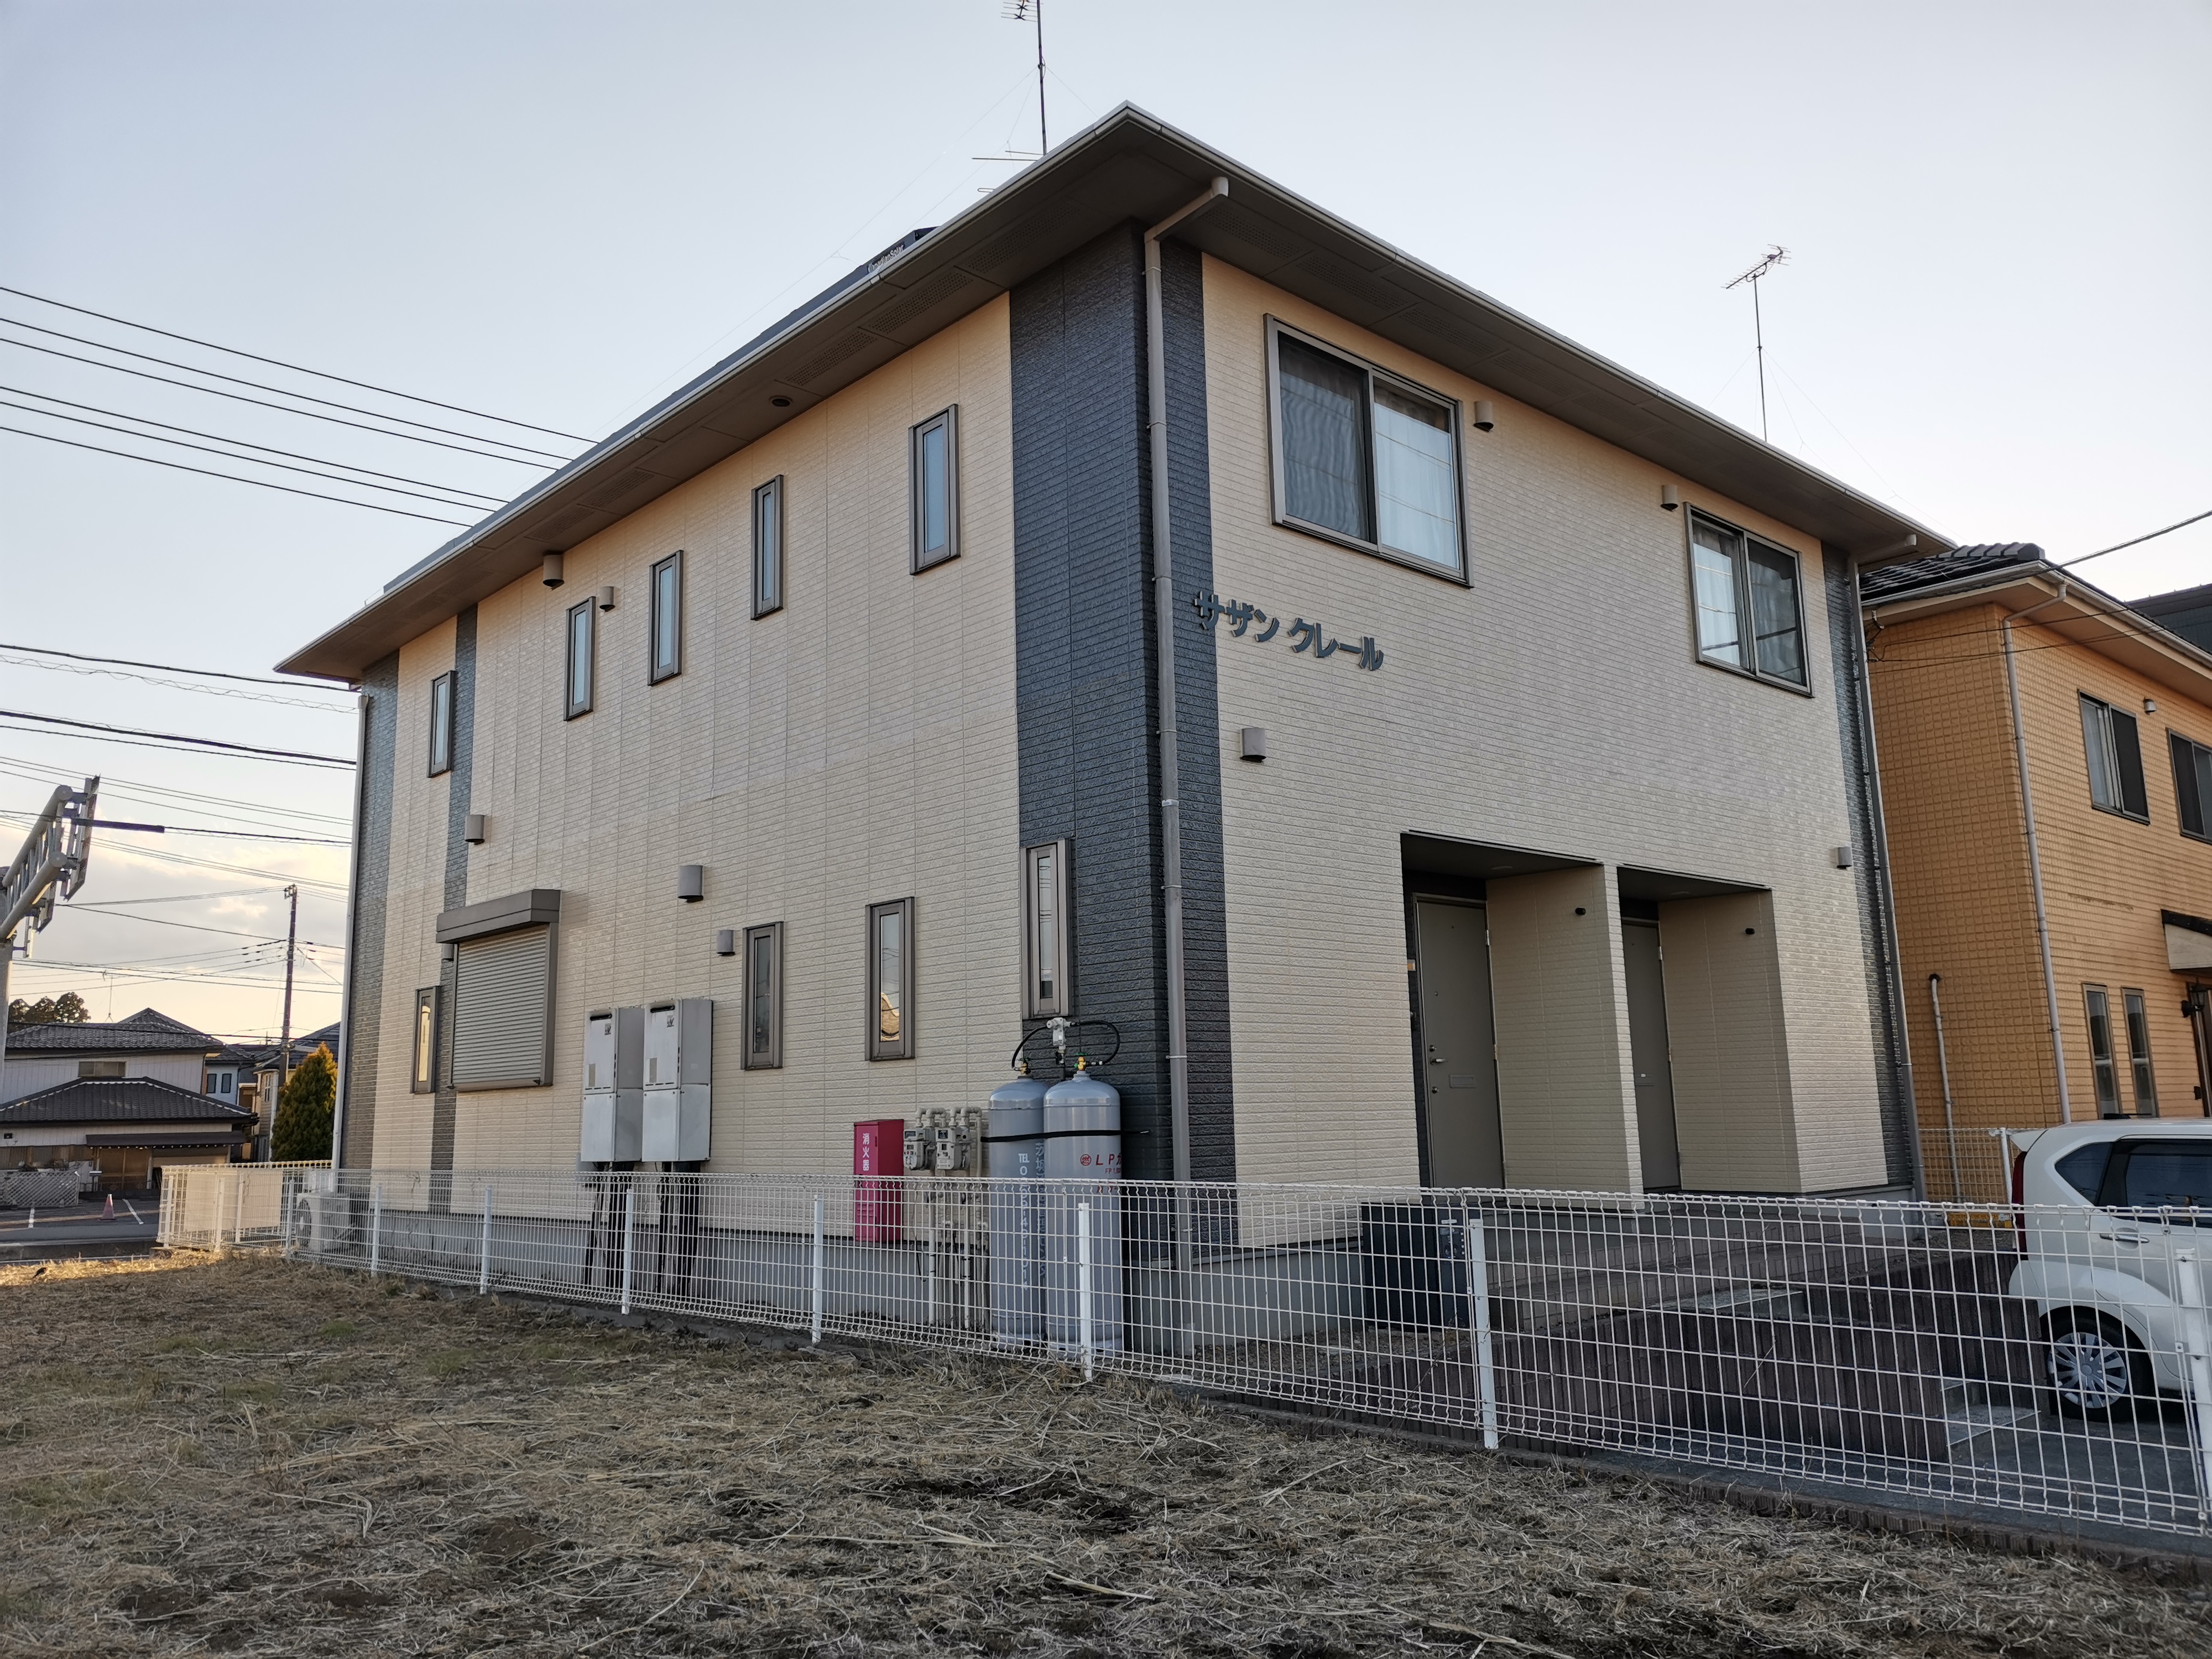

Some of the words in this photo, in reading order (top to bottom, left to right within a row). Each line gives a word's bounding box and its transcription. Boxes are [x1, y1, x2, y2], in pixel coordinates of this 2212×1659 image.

[1193, 590, 1280, 643] サザン
[1287, 617, 1384, 671] クレール
[1018, 1152, 1030, 1163] TEL
